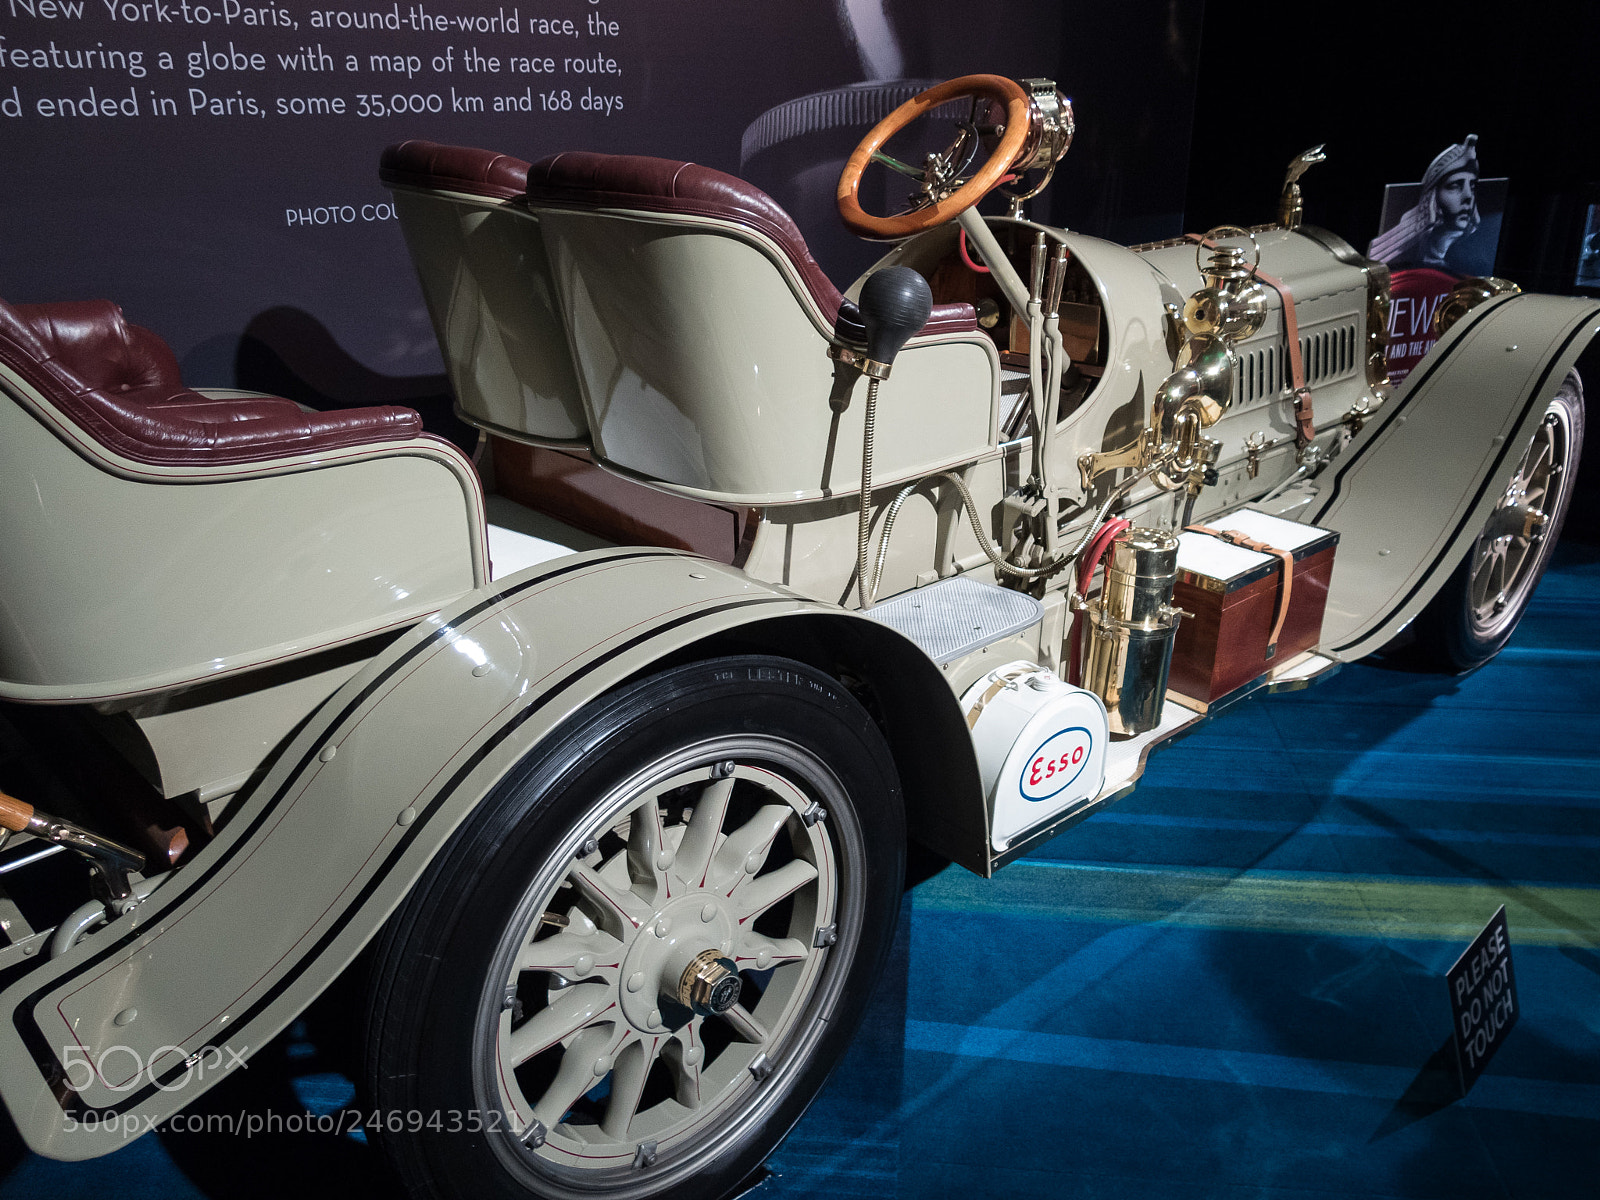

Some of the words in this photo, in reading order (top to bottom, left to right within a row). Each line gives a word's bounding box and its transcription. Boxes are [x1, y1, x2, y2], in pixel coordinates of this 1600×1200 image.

[9, 0, 85, 20] New
[103, 0, 299, 31] York-to-Paris,
[310, 2, 520, 34] around-the-world
[529, 18, 579, 39] race,
[587, 11, 620, 37] the
[0, 35, 147, 78] featuring
[158, 51, 174, 70] a
[187, 40, 266, 79] globe
[276, 43, 334, 72] with
[345, 54, 359, 72] a
[369, 55, 422, 80] map
[431, 45, 455, 73] of
[463, 46, 501, 73] the
[510, 57, 556, 74] race
[564, 51, 622, 77] route,
[36, 86, 140, 117] ended
[150, 90, 178, 116] in
[188, 87, 266, 119] Paris,
[276, 97, 346, 115] some
[355, 93, 443, 117] 35,000
[451, 86, 485, 113] km
[493, 86, 532, 112] and
[539, 89, 573, 112] 168
[580, 86, 624, 117] days
[285, 205, 356, 227] PHOTO
[1390, 343, 1407, 359] AND
[1409, 340, 1424, 356] THE
[1455, 925, 1505, 1005] PLEASE
[1461, 998, 1482, 1038] DO
[1483, 957, 1509, 1010] NOT
[1465, 988, 1513, 1068] TOUCH
